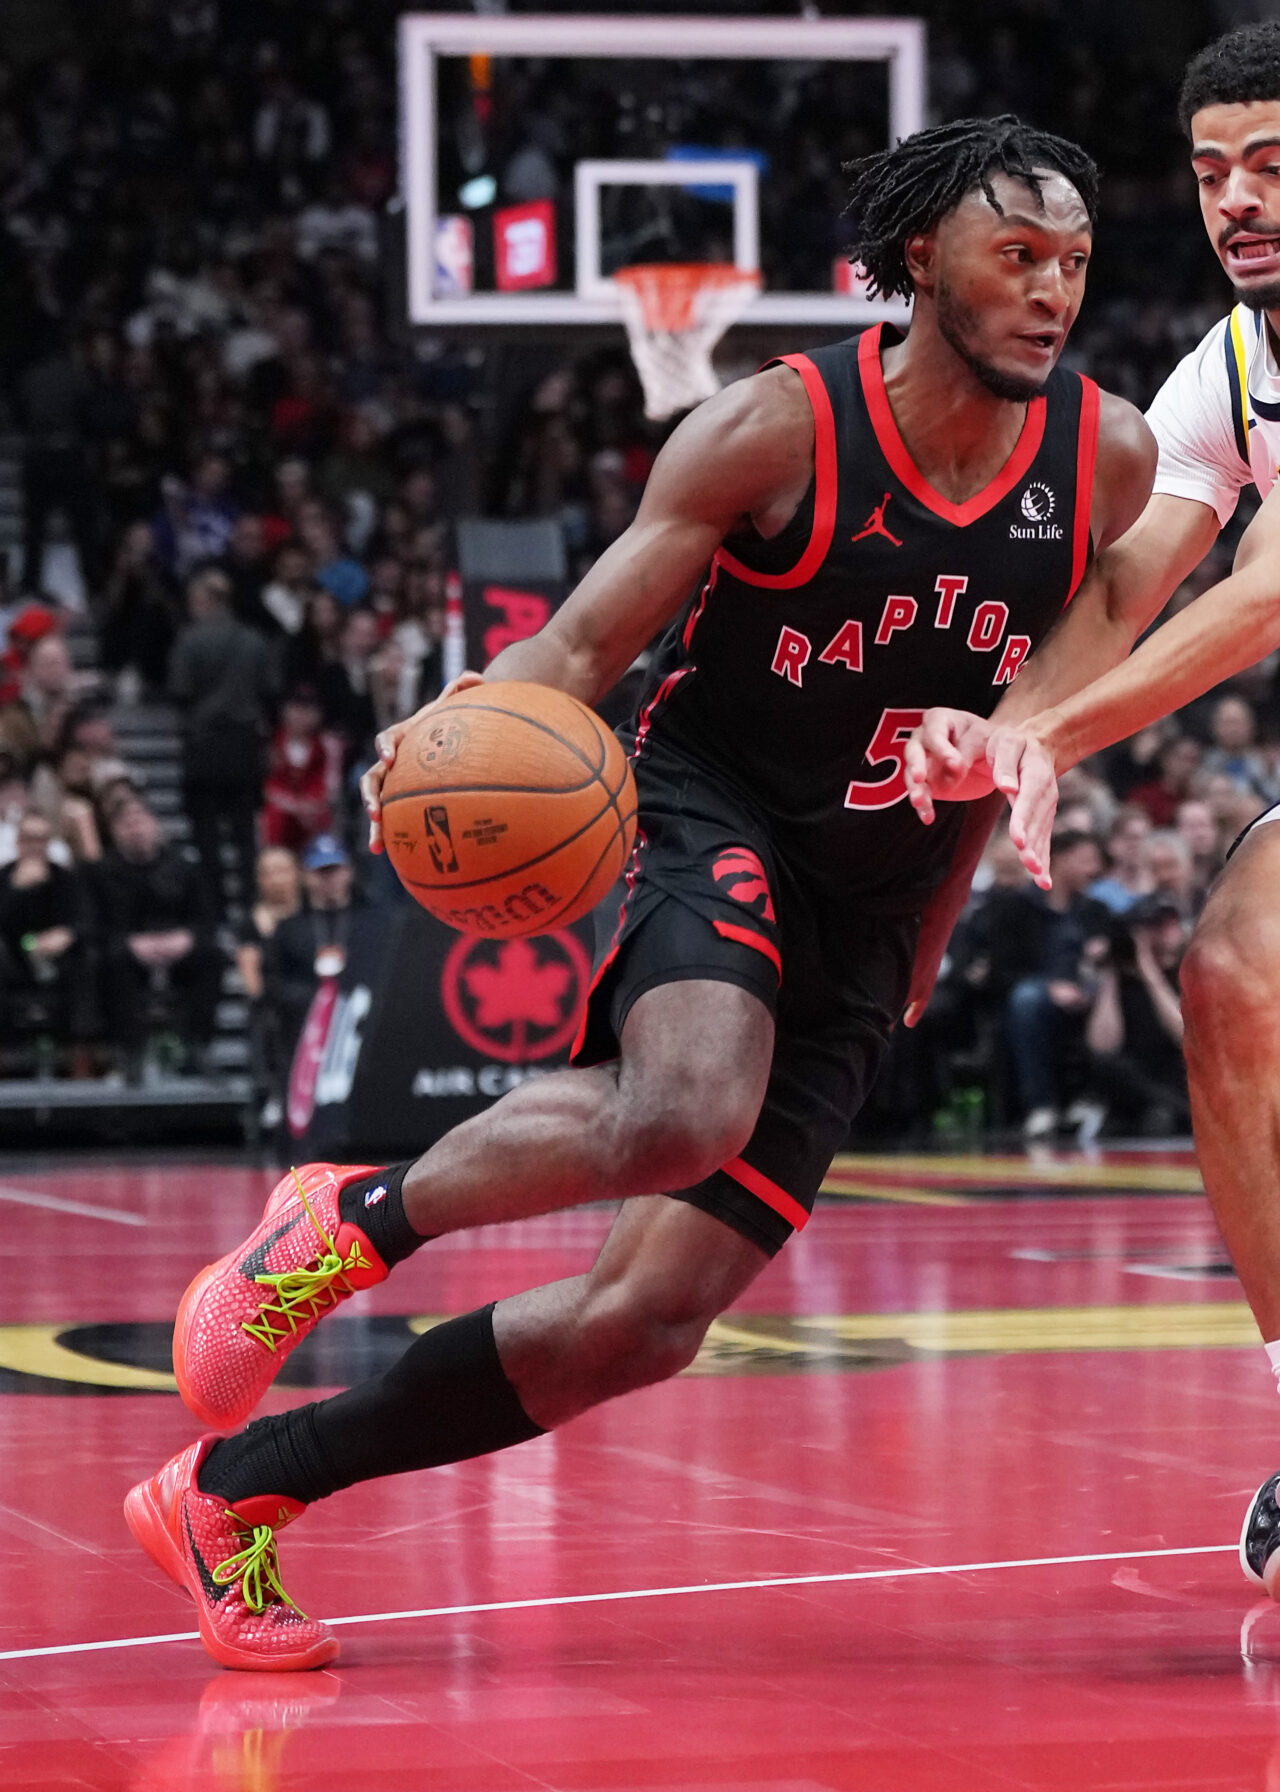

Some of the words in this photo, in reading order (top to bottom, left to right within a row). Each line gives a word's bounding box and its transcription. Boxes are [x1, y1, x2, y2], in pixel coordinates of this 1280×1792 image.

[1009, 524, 1036, 539] Sun
[1038, 523, 1064, 540] Life
[770, 574, 1029, 688] RAPTOR
[843, 707, 929, 811] 5
